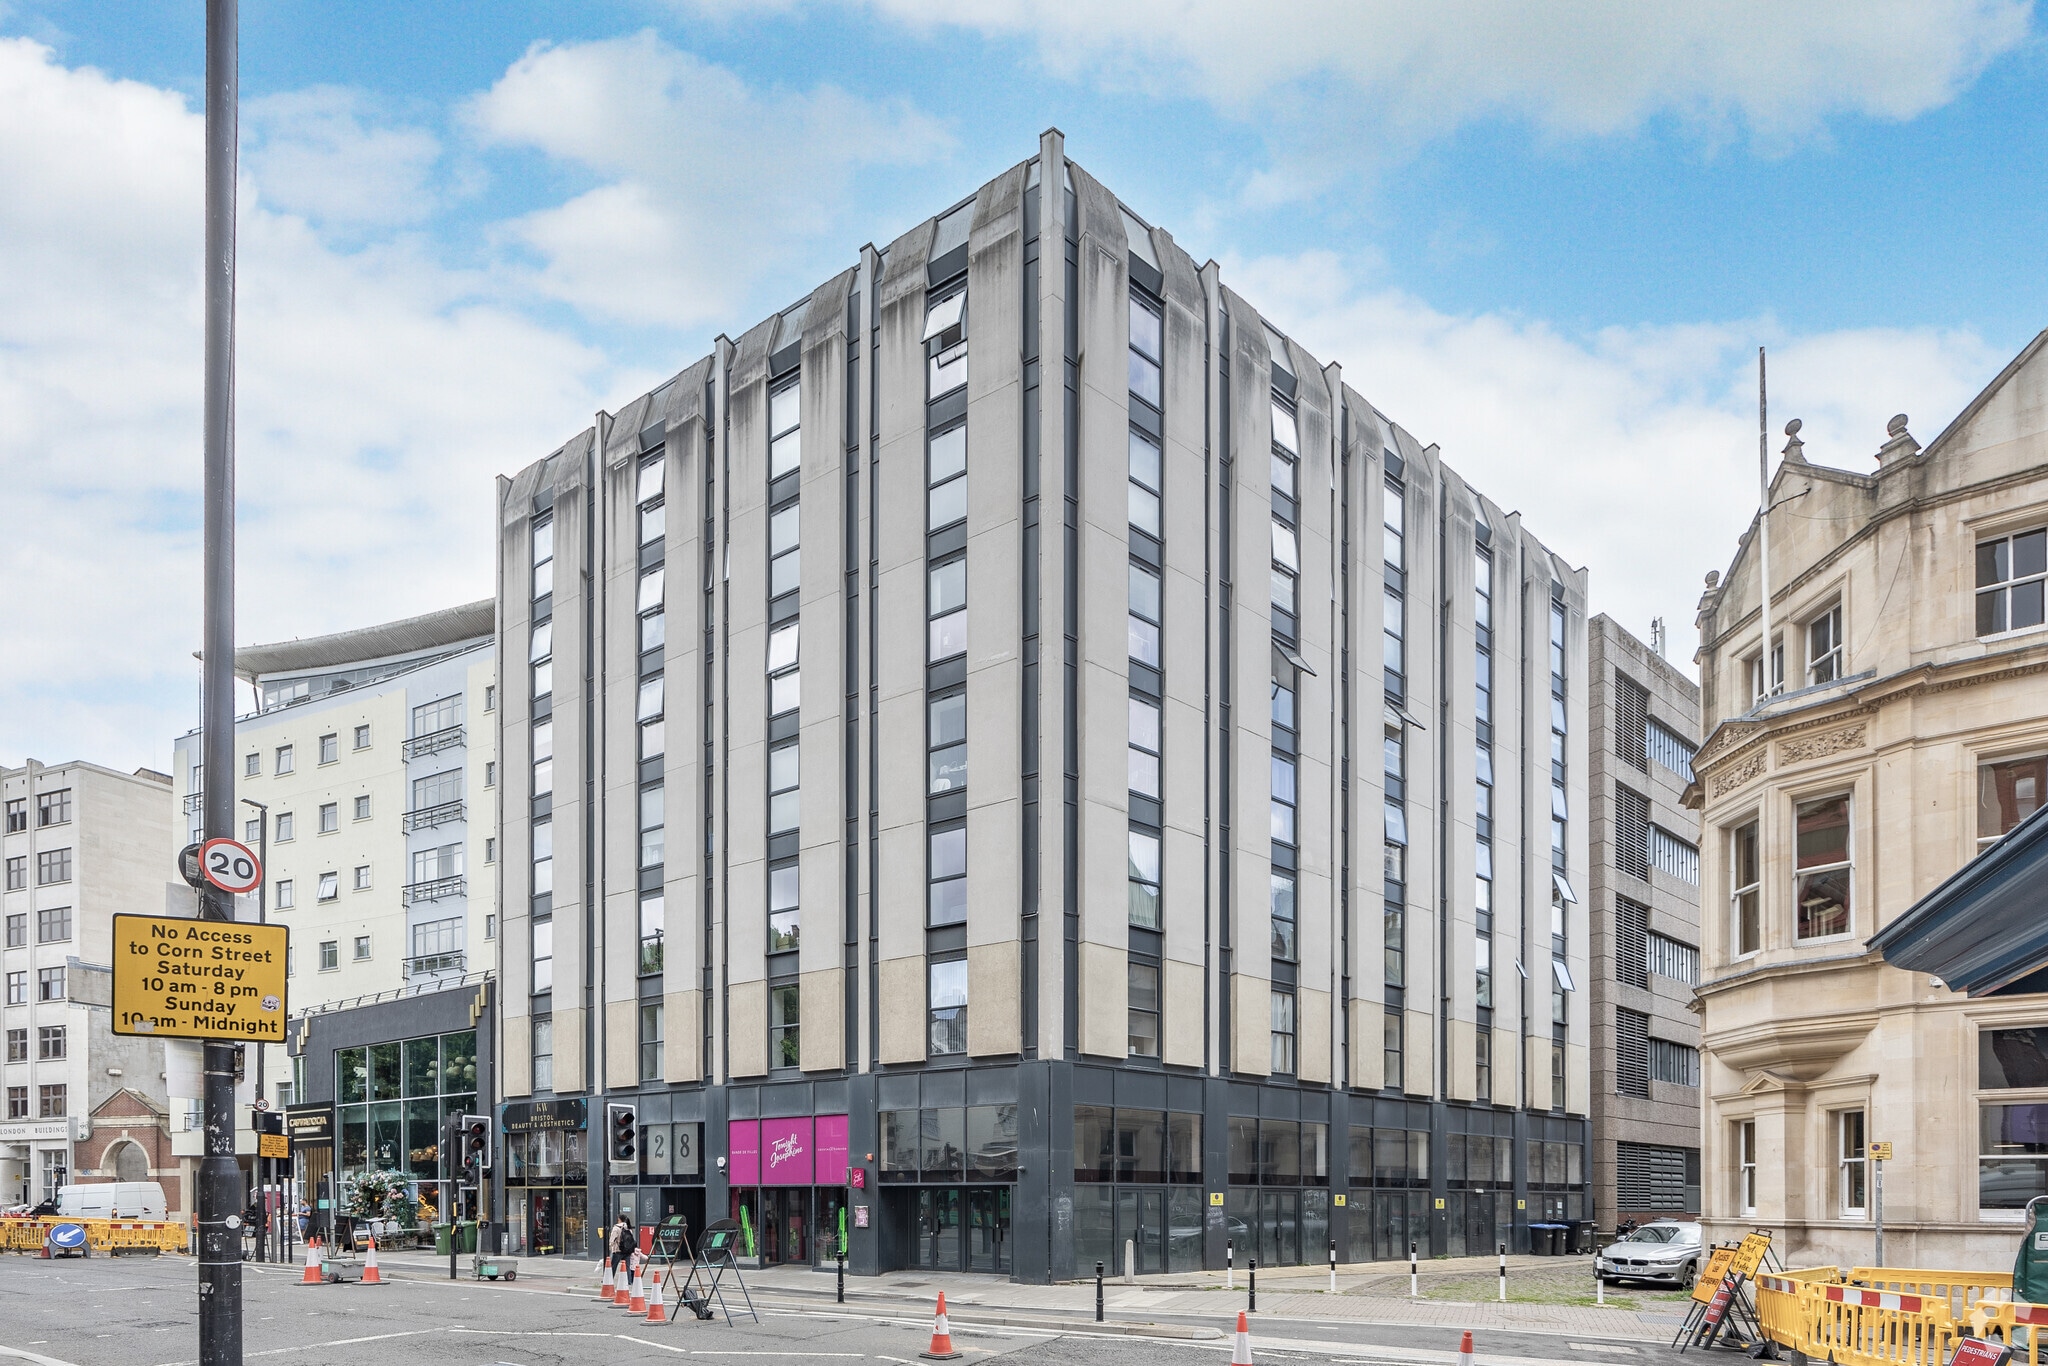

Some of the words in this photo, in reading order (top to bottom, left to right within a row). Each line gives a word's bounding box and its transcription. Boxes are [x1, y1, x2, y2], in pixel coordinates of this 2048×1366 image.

[210, 852, 253, 880] 20
[152, 924, 178, 939] No
[186, 927, 252, 944] Access
[130, 941, 148, 955] to
[157, 943, 203, 958] Corn
[211, 946, 272, 963] Street
[157, 961, 245, 981] Saturday
[142, 978, 164, 991] 10
[169, 982, 196, 994] am
[214, 982, 225, 995] 8
[230, 986, 258, 998] pm
[165, 996, 236, 1015] Sunday
[122, 1012, 144, 1026] 10
[150, 1016, 176, 1028] am
[194, 1016, 278, 1034] Midnight
[540, 1120, 575, 1128] AESTHETICS
[772, 1133, 798, 1152] Tonight
[770, 1146, 803, 1168] Josephine
[1961, 1345, 1997, 1360] PEDESTRIANS
